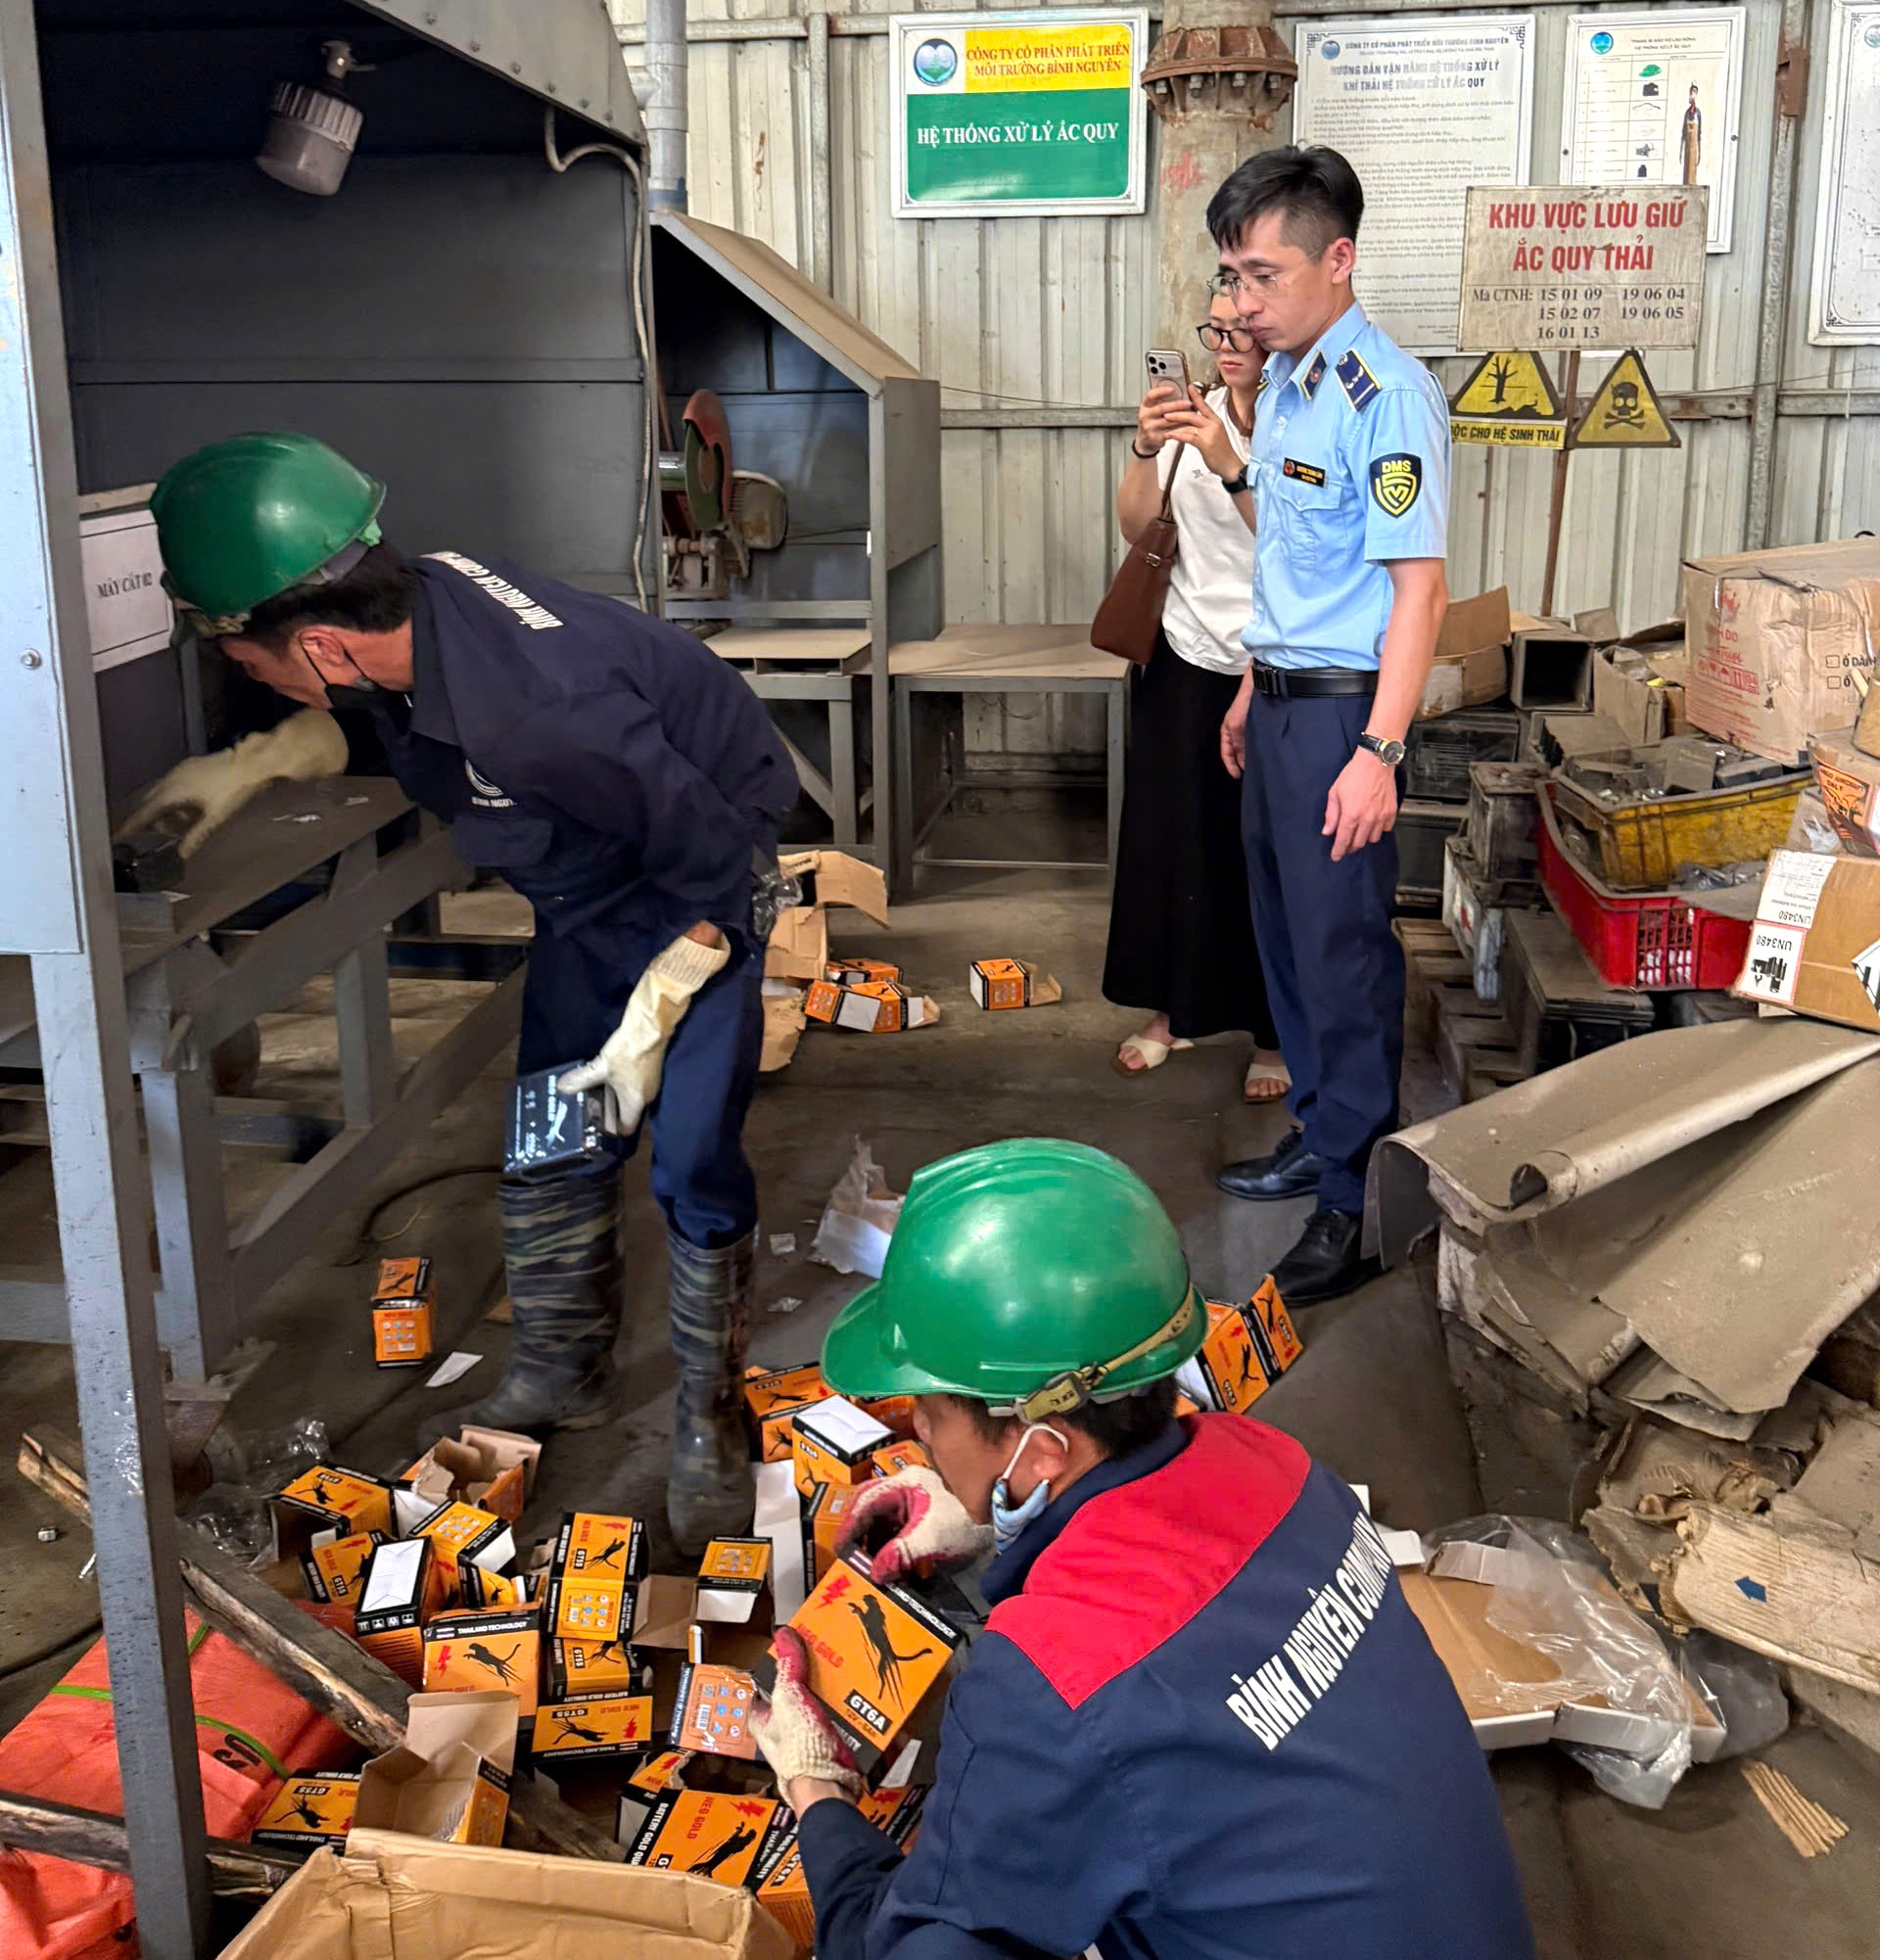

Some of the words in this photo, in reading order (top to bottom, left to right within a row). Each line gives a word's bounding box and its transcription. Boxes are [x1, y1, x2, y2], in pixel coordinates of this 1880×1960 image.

[966, 46, 997, 61] CÔNG
[999, 47, 1012, 60] TY
[1065, 42, 1094, 58] PHÁT
[975, 62, 996, 76] MÔI
[999, 60, 1045, 75] TRƯỜNG
[1048, 59, 1073, 73] BÌNH
[1076, 57, 1121, 73] NGUYÊN
[1467, 77, 1485, 88] QUY
[916, 125, 940, 149] HỆ
[942, 122, 1001, 145] THỐNG
[1004, 120, 1030, 143] XỬ
[1031, 119, 1054, 141] LÝ
[1083, 122, 1119, 143] QUY
[1488, 203, 1535, 229] KHU
[1543, 200, 1587, 235] VỰC
[1594, 200, 1639, 229] LƯU
[1645, 196, 1688, 228] GIỮ
[1513, 238, 1544, 271] ẮC
[1550, 245, 1596, 274] QUY
[1604, 234, 1654, 271] THẢI
[1493, 288, 1533, 302] CTNH:
[1540, 288, 1558, 302] 15
[1562, 288, 1577, 301] 01
[1584, 287, 1603, 301] 09
[1622, 288, 1639, 301] 19
[1644, 288, 1662, 301] 06
[1667, 288, 1685, 301] 04
[1539, 307, 1557, 320] 15
[1561, 307, 1577, 320] 02
[1582, 307, 1601, 320] 07
[1621, 306, 1637, 319] 19
[1642, 306, 1661, 319] 06
[1666, 306, 1684, 319] 05
[1537, 327, 1554, 339] 16
[1559, 327, 1574, 339] 01
[1582, 326, 1600, 339] 13
[1470, 426, 1490, 439] CHO
[1493, 426, 1506, 443] HỆ
[1509, 428, 1533, 442] SINH
[1536, 426, 1560, 442] THÁI
[1382, 460, 1411, 473] DMS
[1778, 909, 1811, 925] UN3480
[1756, 934, 1793, 952] UN3480
[1226, 1655, 1312, 1750] BÌNH
[1283, 1583, 1366, 1700] NGUYÊN
[849, 1694, 886, 1731] GT6A
[648, 1801, 670, 1833] BATTERY
[685, 1814, 707, 1840] GOLD
[638, 1832, 654, 1851] GOLD
